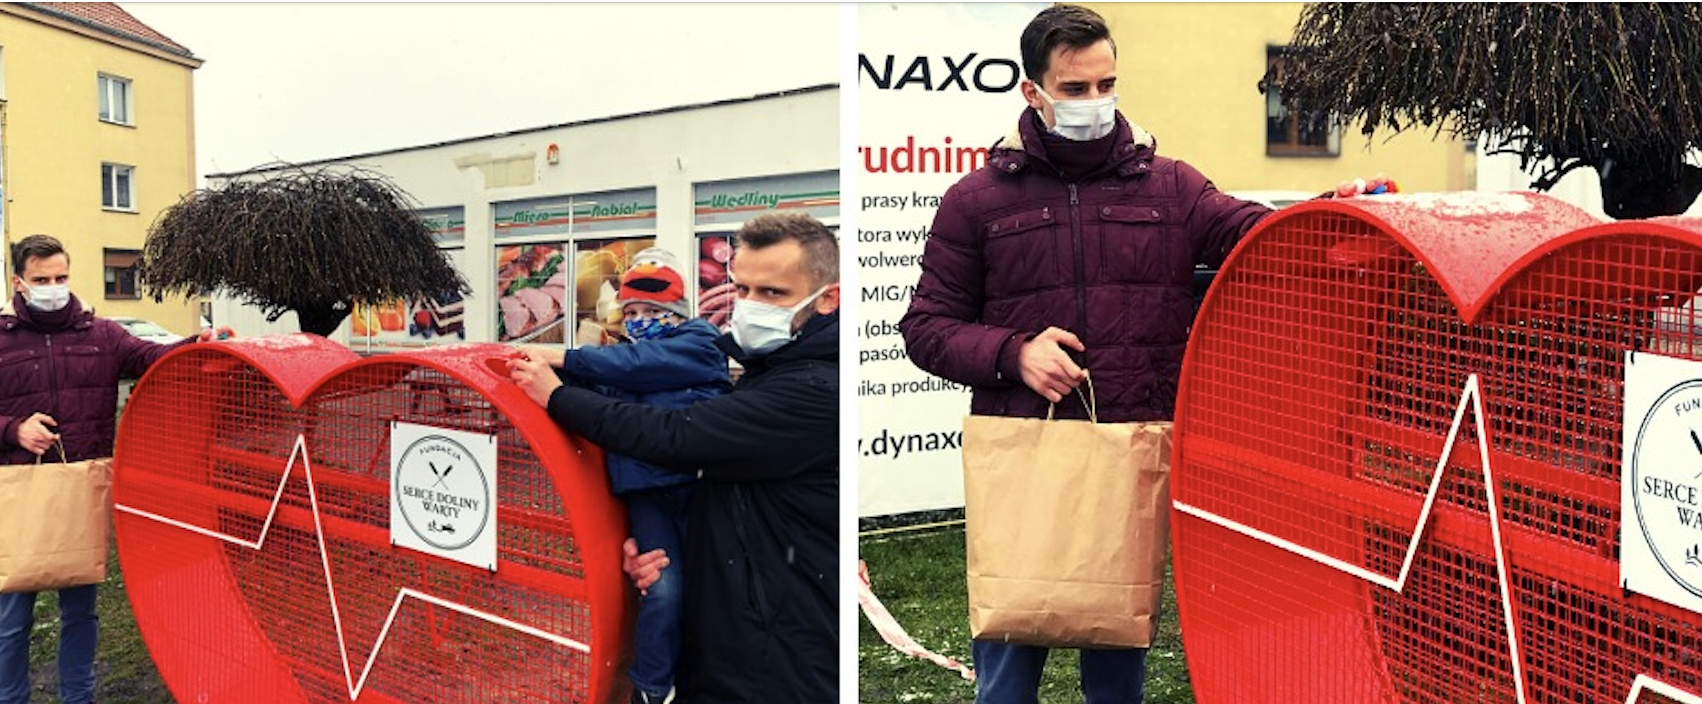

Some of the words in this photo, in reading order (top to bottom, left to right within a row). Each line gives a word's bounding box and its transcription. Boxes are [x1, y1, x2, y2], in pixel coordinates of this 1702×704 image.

[858, 52, 1020, 93] NAXO
[858, 136, 990, 174] udnim
[861, 196, 908, 211] prasy
[403, 486, 433, 501] SERCE
[437, 492, 479, 511] DOLINY
[1643, 476, 1698, 506] SERCE
[422, 502, 460, 518] WARTY
